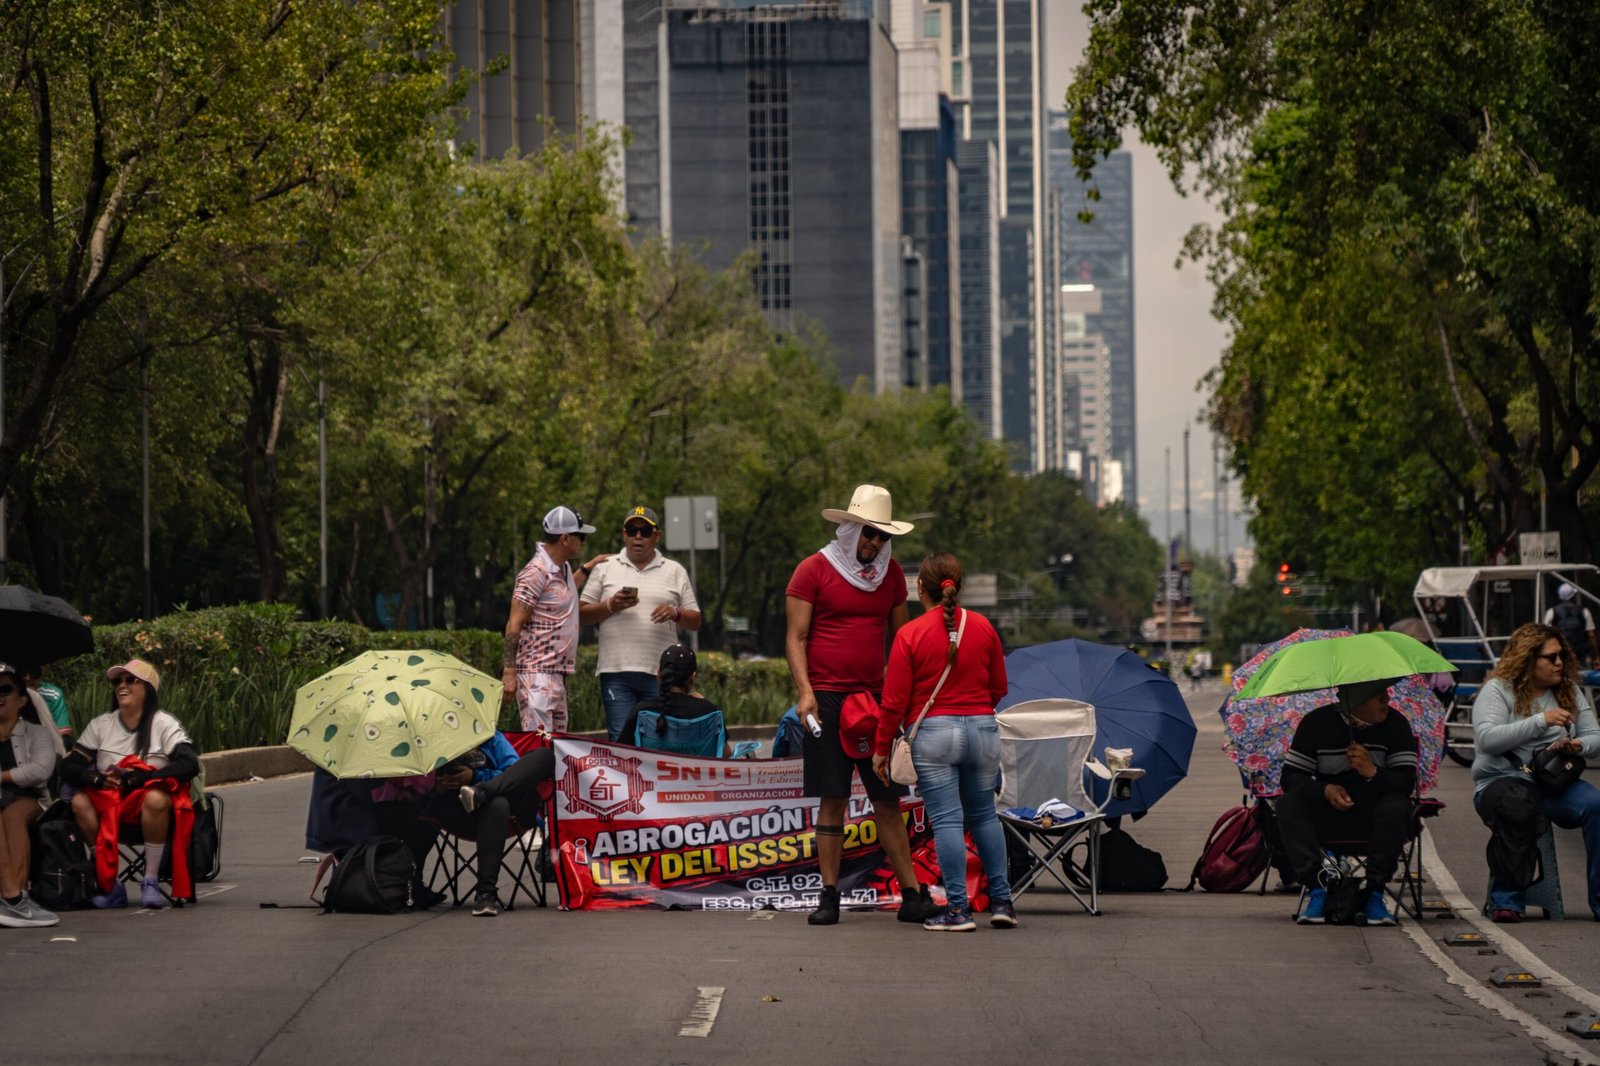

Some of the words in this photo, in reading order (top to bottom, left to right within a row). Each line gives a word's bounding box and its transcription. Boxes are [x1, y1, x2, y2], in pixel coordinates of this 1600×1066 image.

[665, 792, 705, 801] UNIDAD
[721, 789, 796, 800] ORGANIZACIÓN
[591, 856, 651, 885] LEY
[660, 848, 720, 880] DEL
[728, 831, 816, 872] ISSST
[746, 877, 790, 893] C.T.
[792, 873, 824, 890] 92
[702, 896, 750, 909] ESC.
[852, 888, 877, 904] 71
